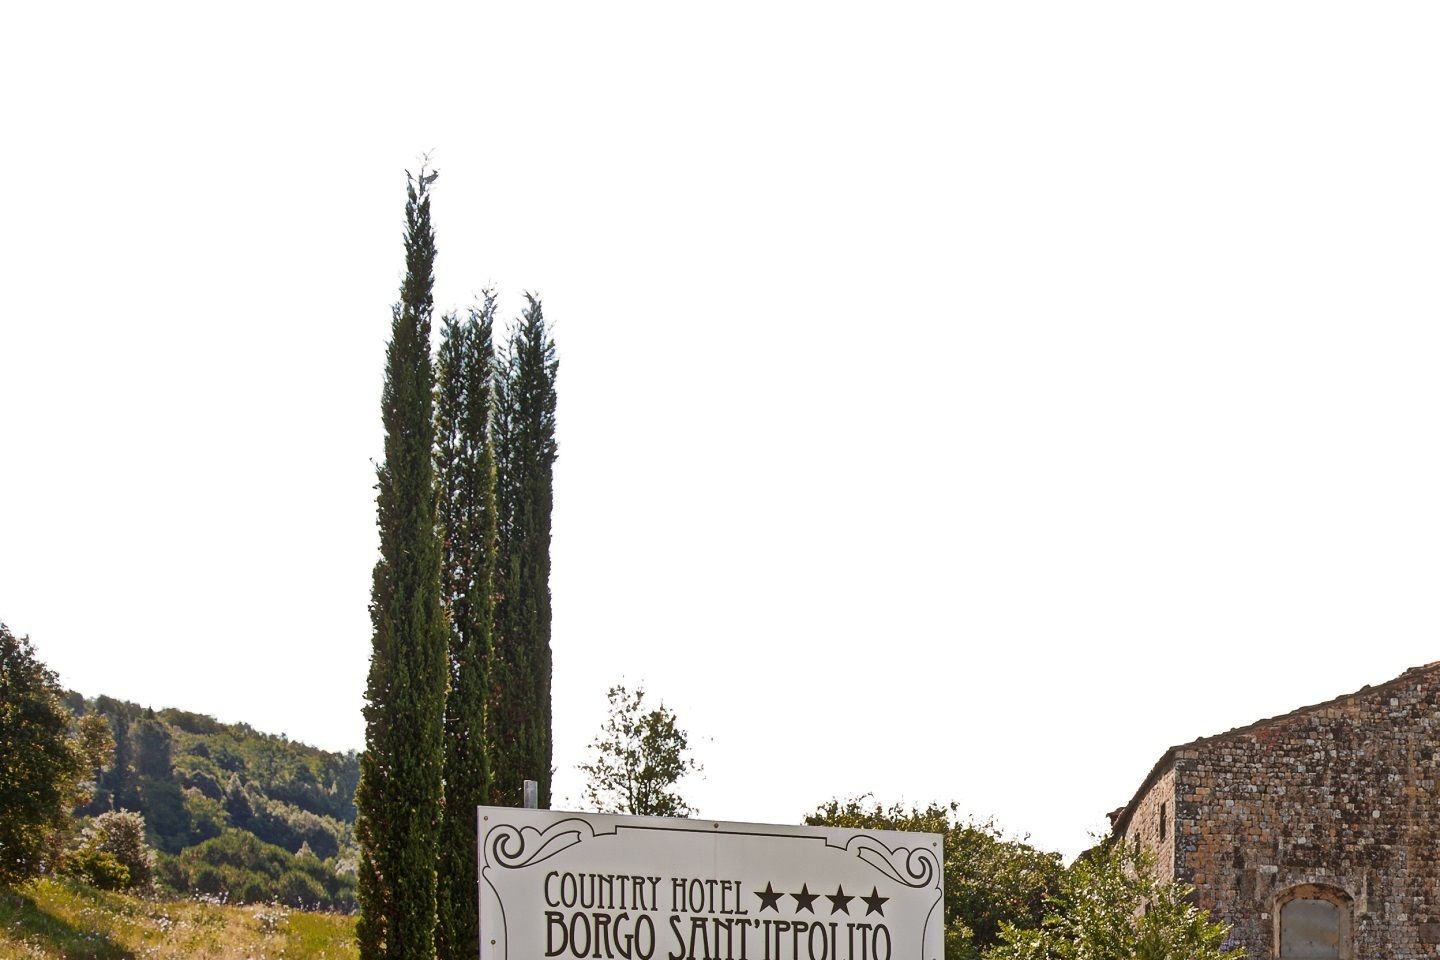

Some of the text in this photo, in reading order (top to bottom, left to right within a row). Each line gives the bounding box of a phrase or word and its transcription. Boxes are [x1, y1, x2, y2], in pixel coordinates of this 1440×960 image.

[544, 870, 749, 915] COUNTRY HOTEL
[544, 910, 656, 960] BORGO
